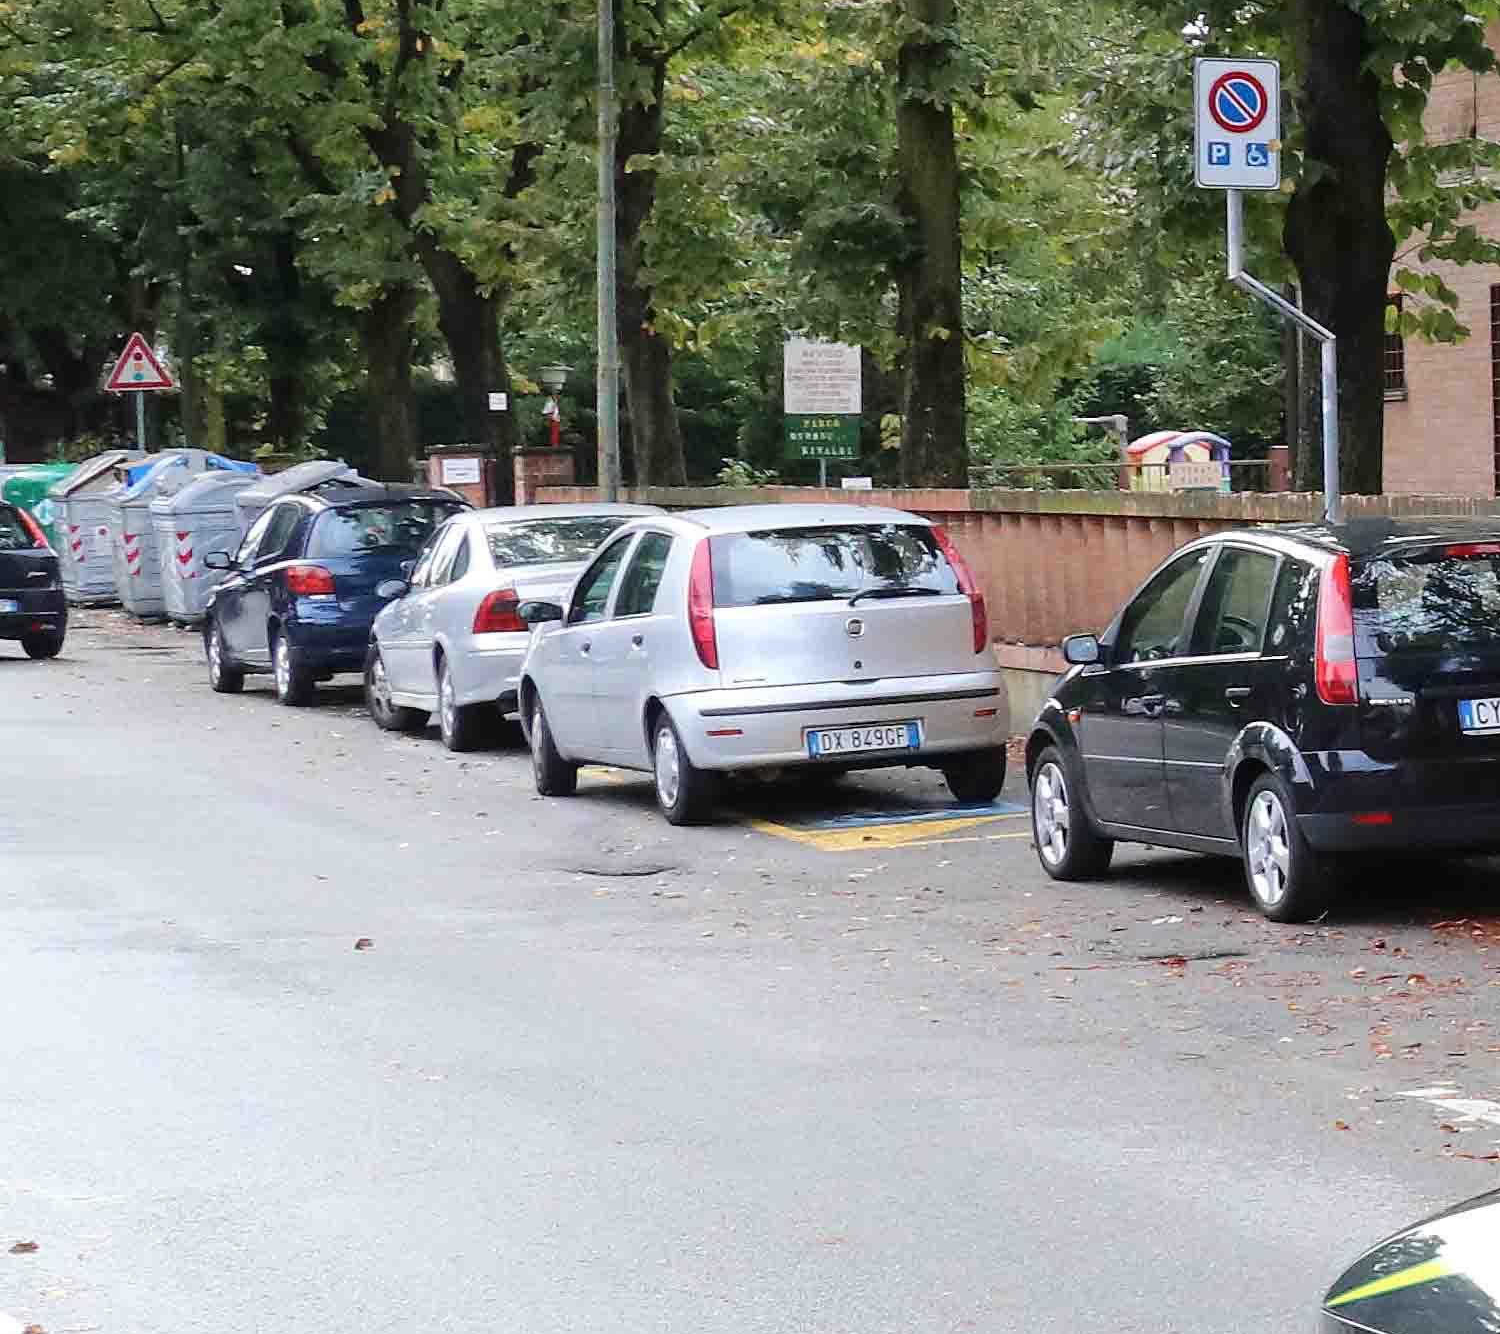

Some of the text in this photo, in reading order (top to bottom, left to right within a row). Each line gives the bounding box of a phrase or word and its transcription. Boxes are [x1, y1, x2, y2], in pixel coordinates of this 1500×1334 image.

[1211, 143, 1227, 164] P
[1475, 700, 1500, 724] CY
[821, 726, 905, 752] DX 849GF
